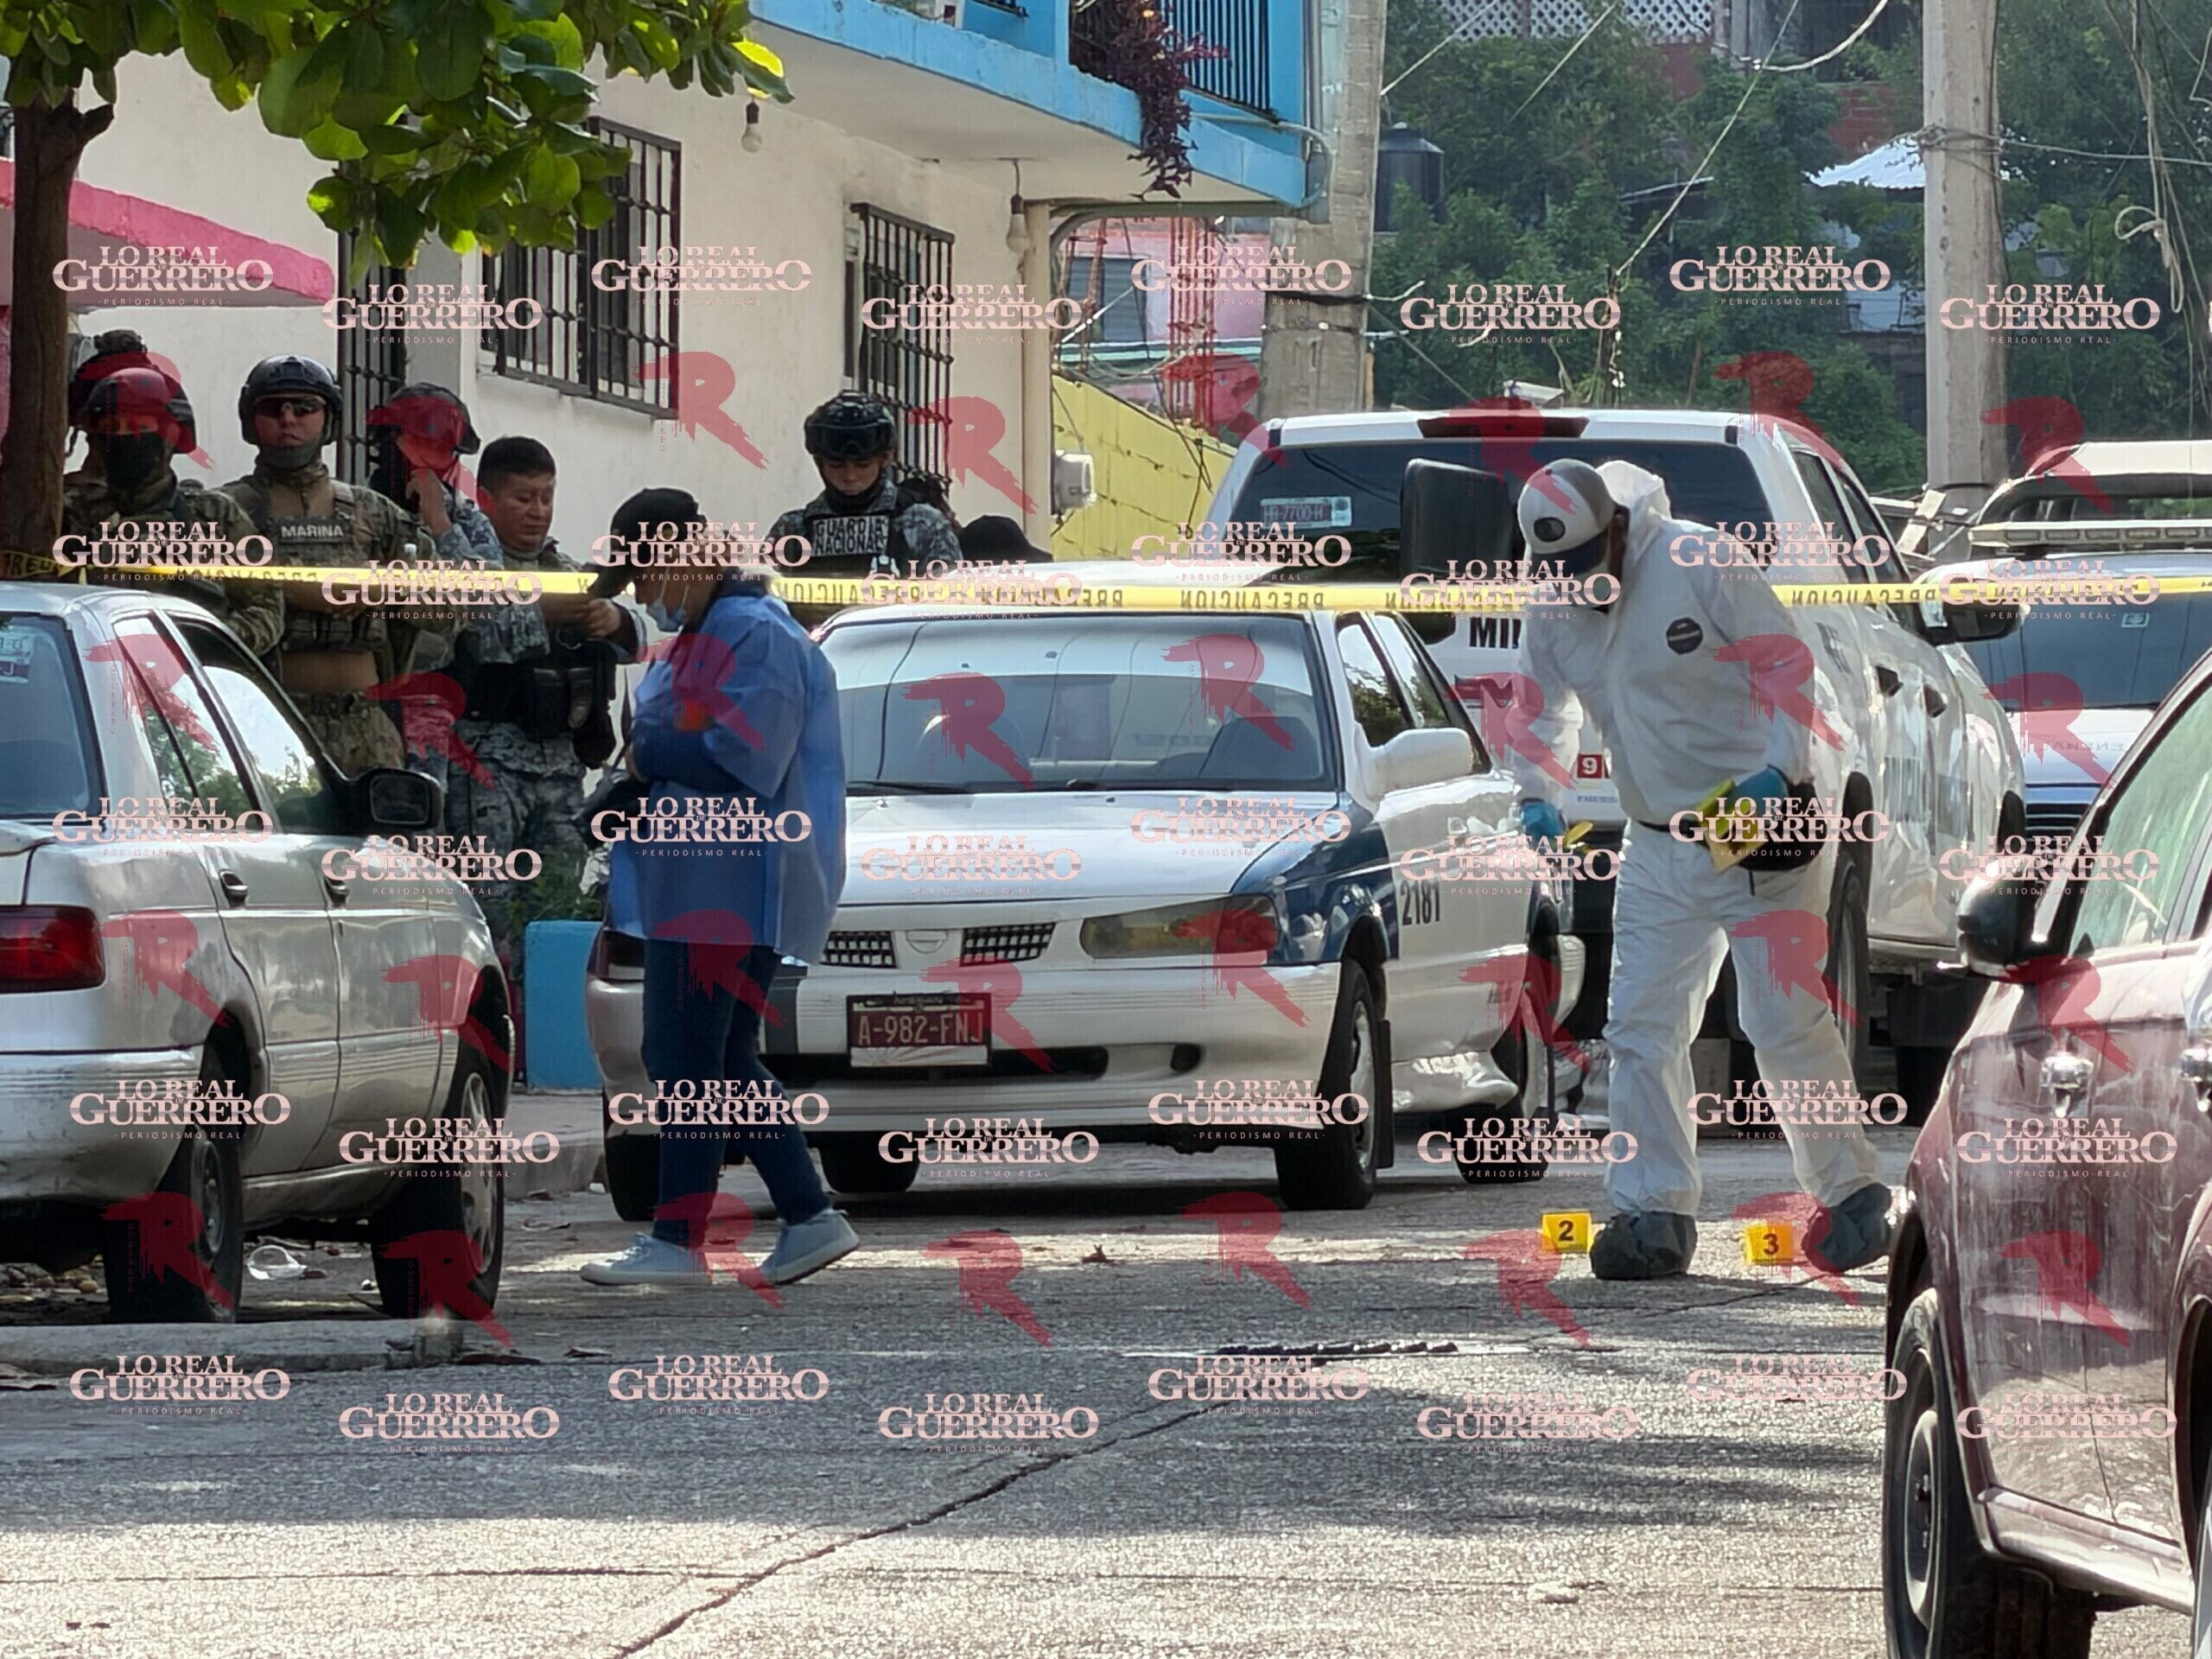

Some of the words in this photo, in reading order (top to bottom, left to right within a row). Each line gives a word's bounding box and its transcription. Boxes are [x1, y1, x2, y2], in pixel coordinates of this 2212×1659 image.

[281, 524, 345, 537] MARINA
[816, 518, 883, 536] GUARDIA
[815, 532, 884, 555] NACIONAL
[1400, 880, 1440, 926] 2181
[859, 1012, 983, 1046] A-982-FNJ
[1558, 1220, 1573, 1242] 2
[1764, 1234, 1779, 1255] 3
